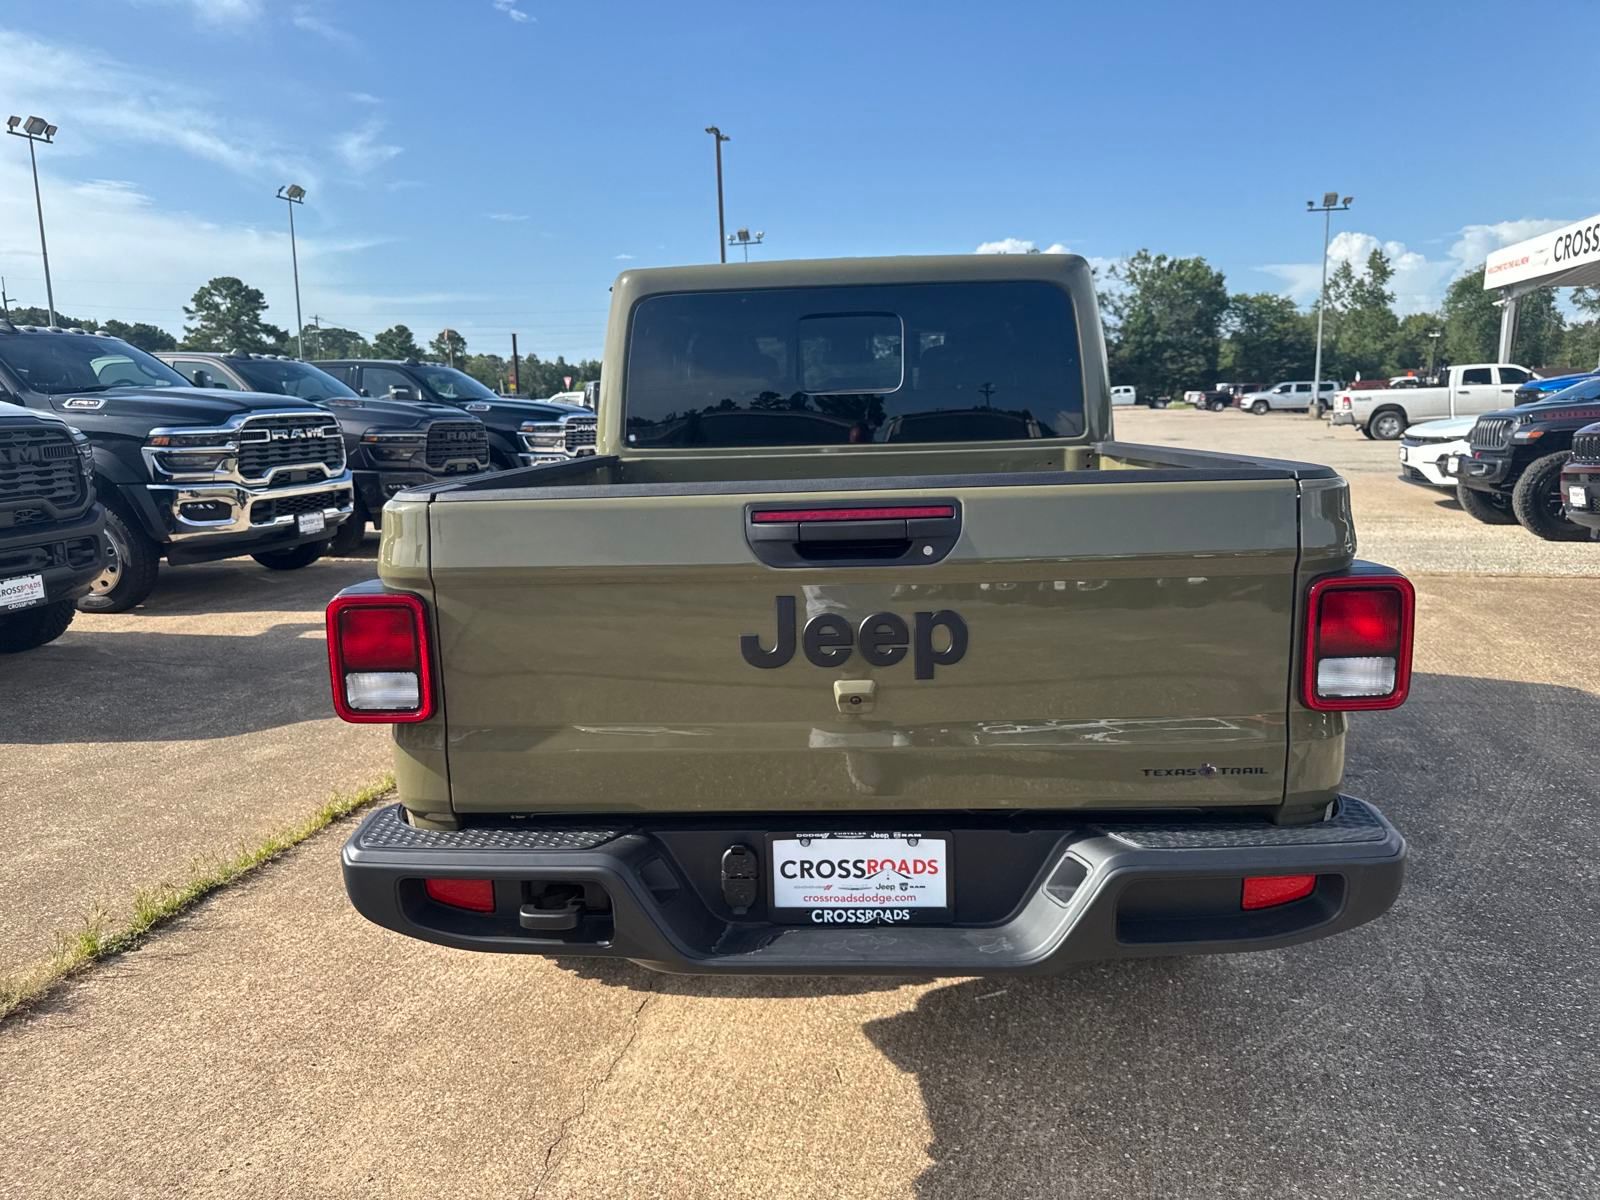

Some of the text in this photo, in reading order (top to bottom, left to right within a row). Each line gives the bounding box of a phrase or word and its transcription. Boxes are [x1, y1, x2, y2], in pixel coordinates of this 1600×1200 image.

[271, 427, 322, 440] RAM
[446, 431, 477, 440] RAM
[0, 581, 41, 598] ROSSROADS
[739, 595, 969, 680] Jeep
[1142, 767, 1268, 776] TEXAS TRAIL
[870, 832, 890, 840] Jeep
[780, 859, 938, 879] CROSSROADS
[875, 883, 896, 891] Jeep
[803, 893, 917, 904] crossroadsdodge.com
[811, 909, 910, 923] CROSSROADS
